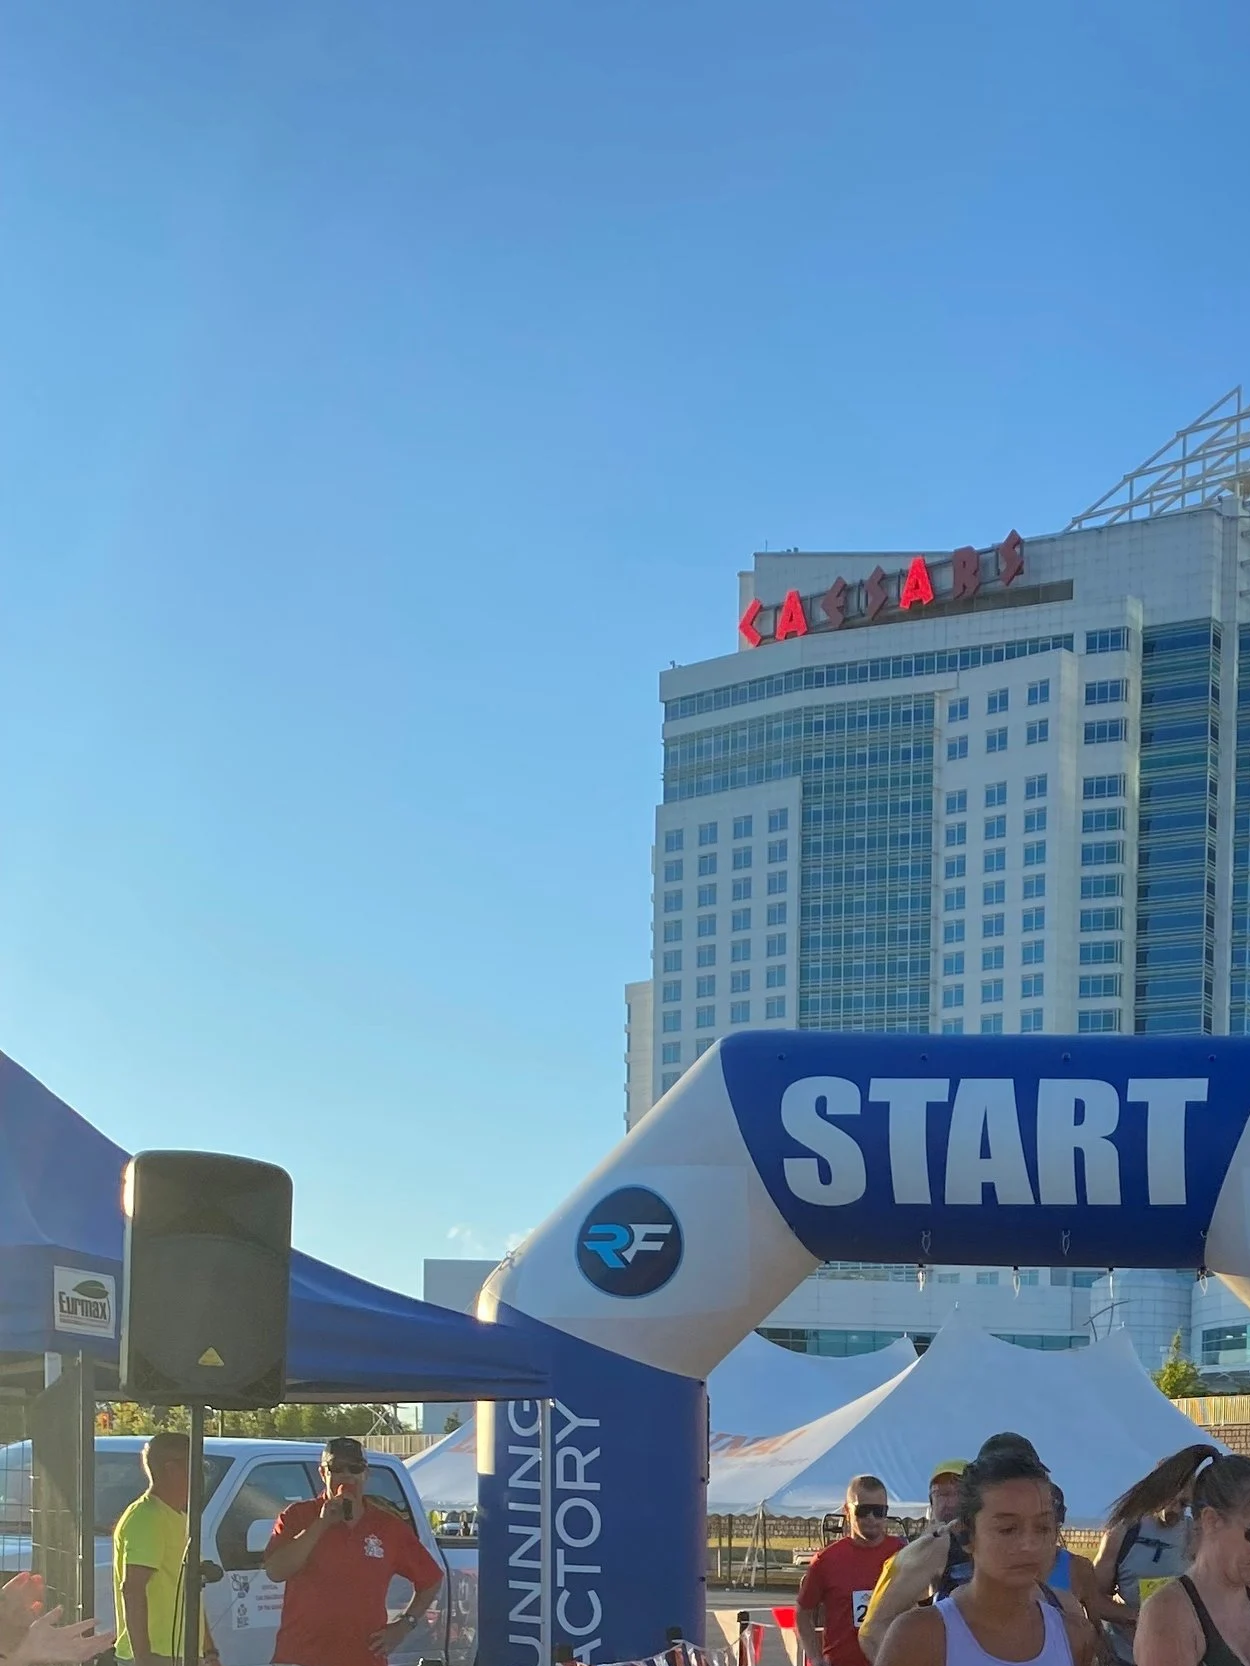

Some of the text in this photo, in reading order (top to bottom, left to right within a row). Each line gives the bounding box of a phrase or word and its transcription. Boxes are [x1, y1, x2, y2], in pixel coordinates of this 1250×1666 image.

[738, 529, 1024, 648] CAESARS
[780, 1076, 1209, 1206] START
[584, 1224, 673, 1268] RF
